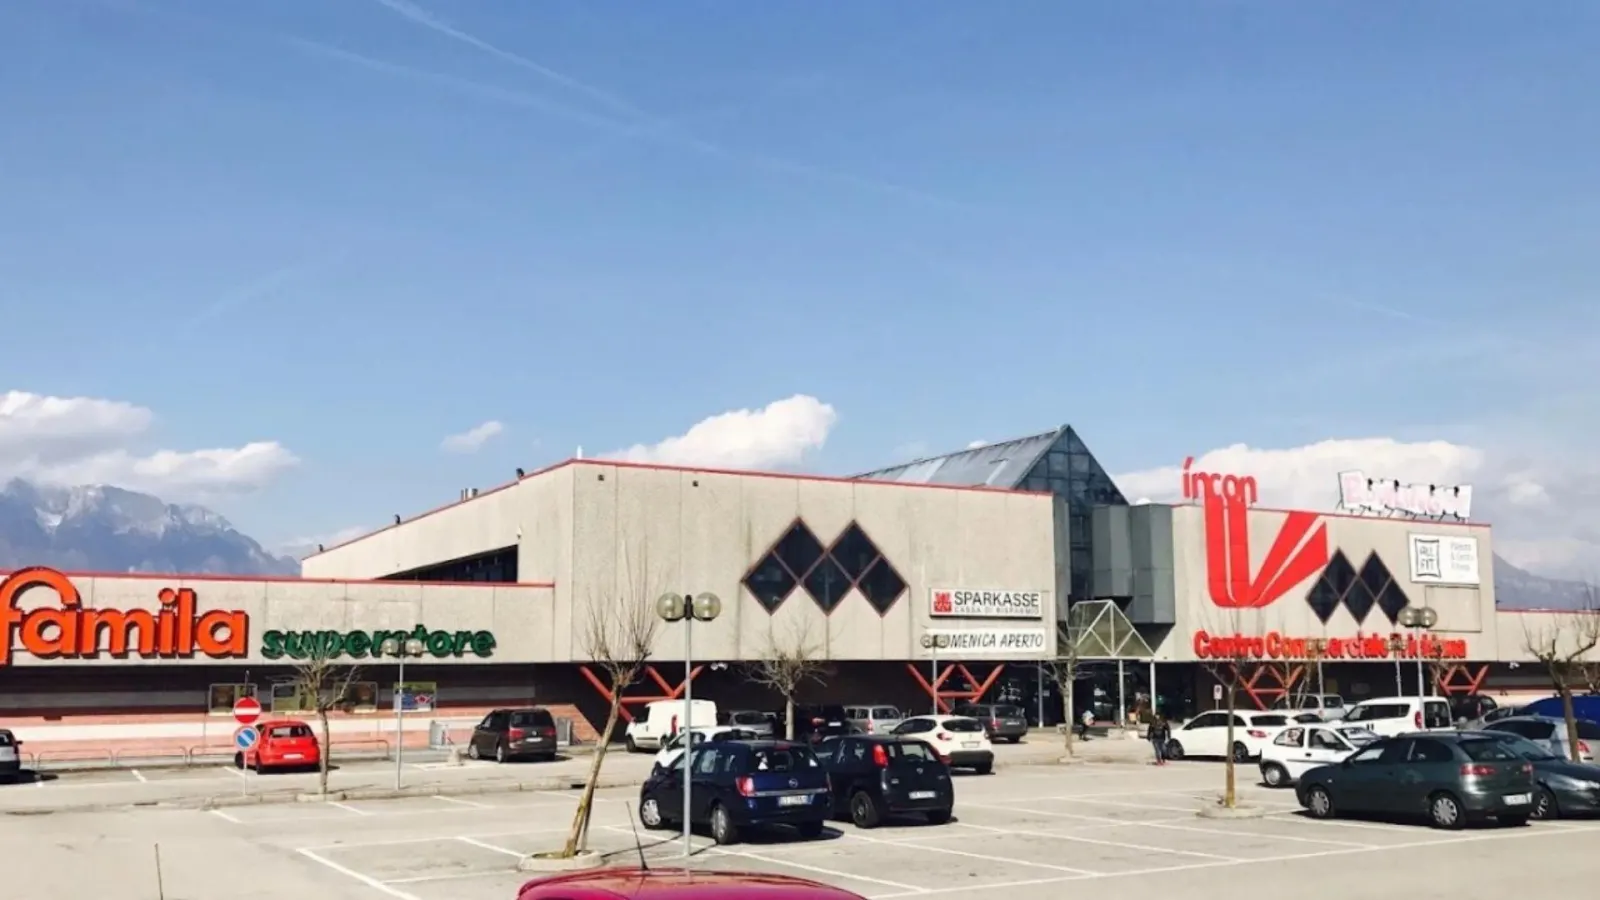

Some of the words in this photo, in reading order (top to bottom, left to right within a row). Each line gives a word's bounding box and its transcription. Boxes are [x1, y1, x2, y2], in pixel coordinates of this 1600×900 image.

[954, 591, 1040, 607] SPARKASSE
[0, 566, 249, 665] famila
[934, 633, 997, 649] MENICA
[999, 634, 1044, 649] APERTO
[1194, 630, 1264, 659] Centro
[1266, 631, 1389, 659] Comerciale
